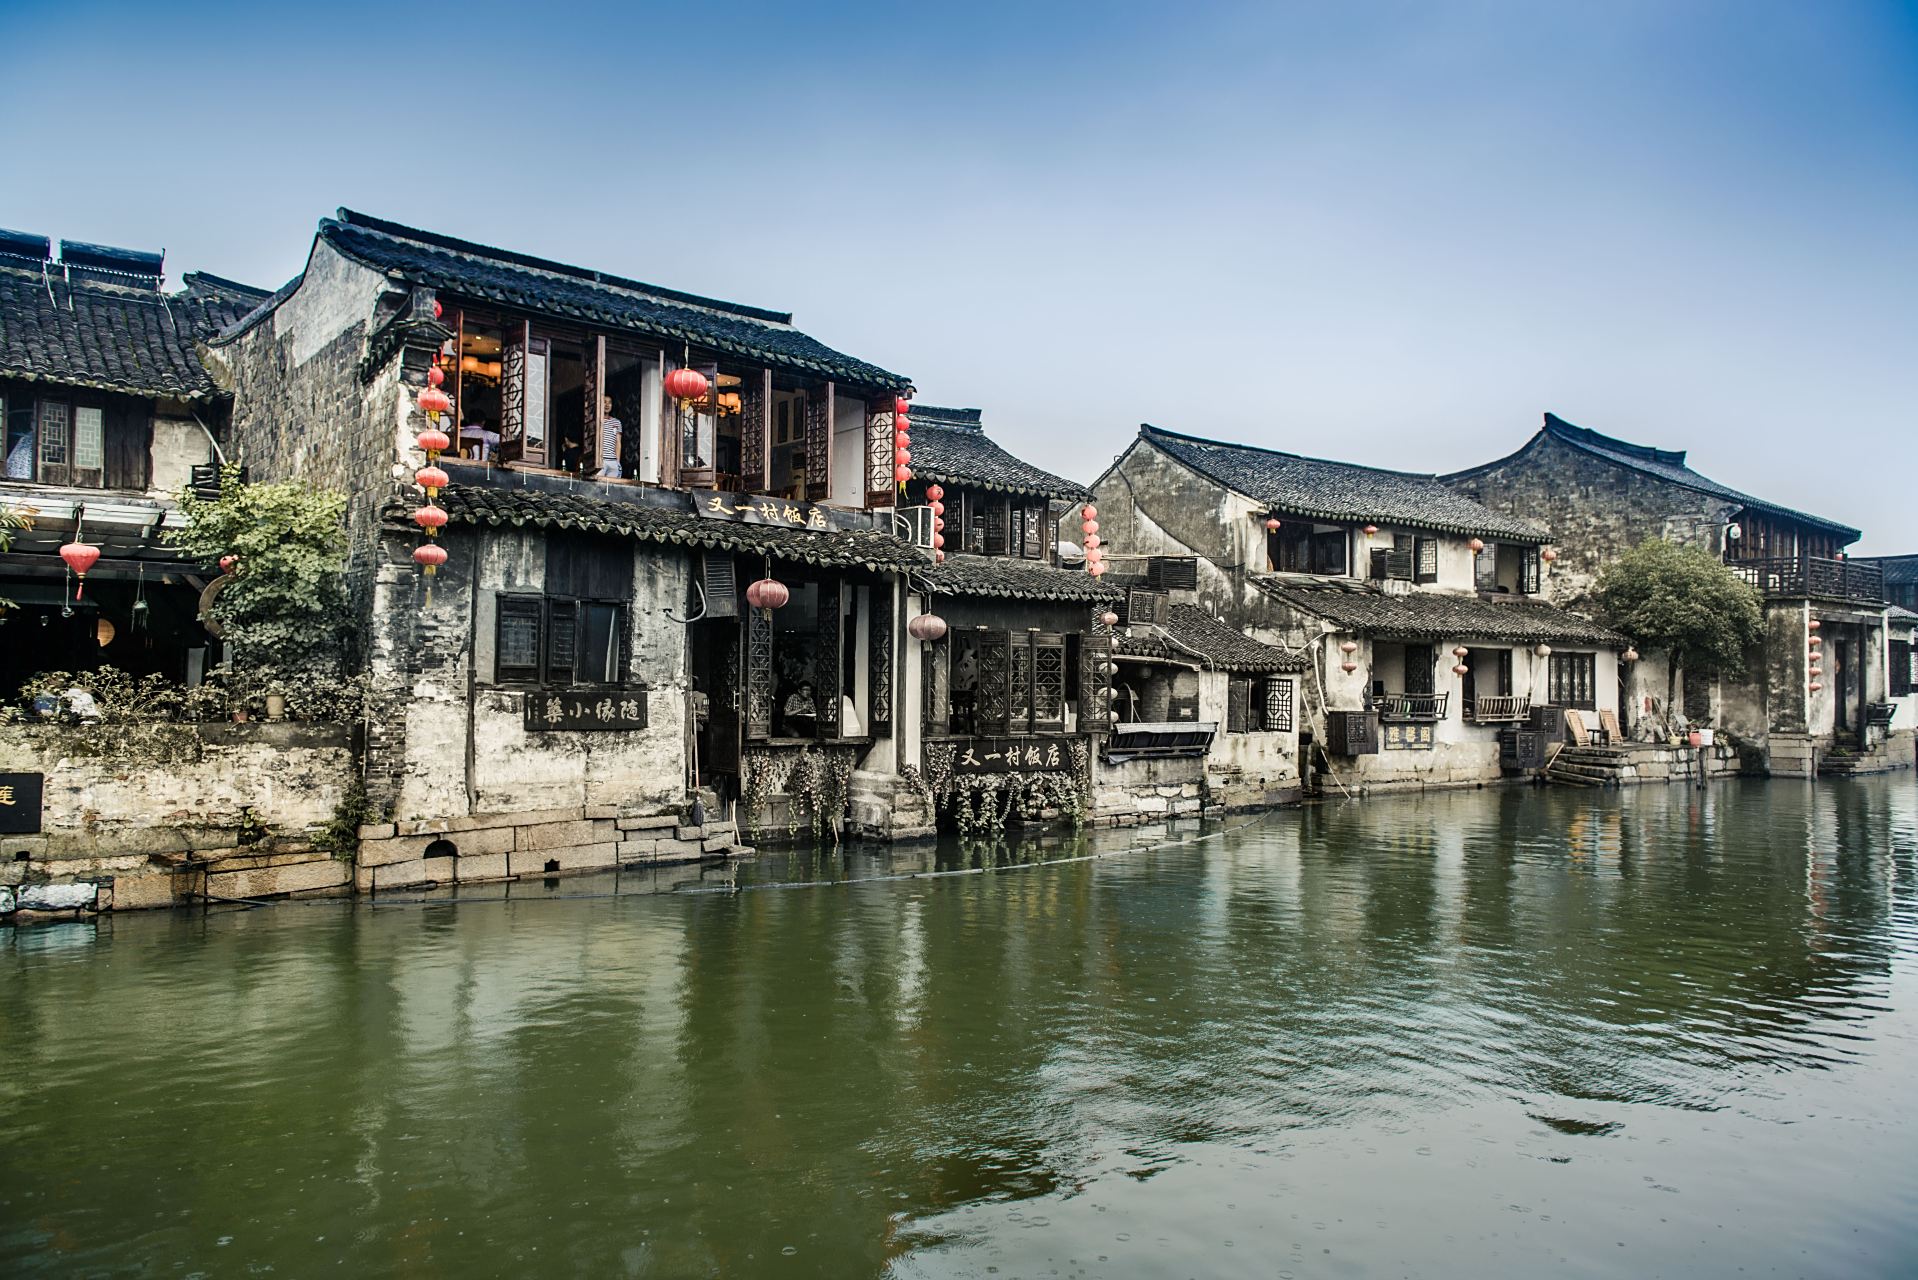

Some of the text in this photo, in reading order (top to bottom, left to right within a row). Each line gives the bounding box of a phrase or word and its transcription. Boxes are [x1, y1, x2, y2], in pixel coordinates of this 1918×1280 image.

[707, 497, 826, 528] 又一村饭店
[960, 743, 1060, 768] 又一村饭店
